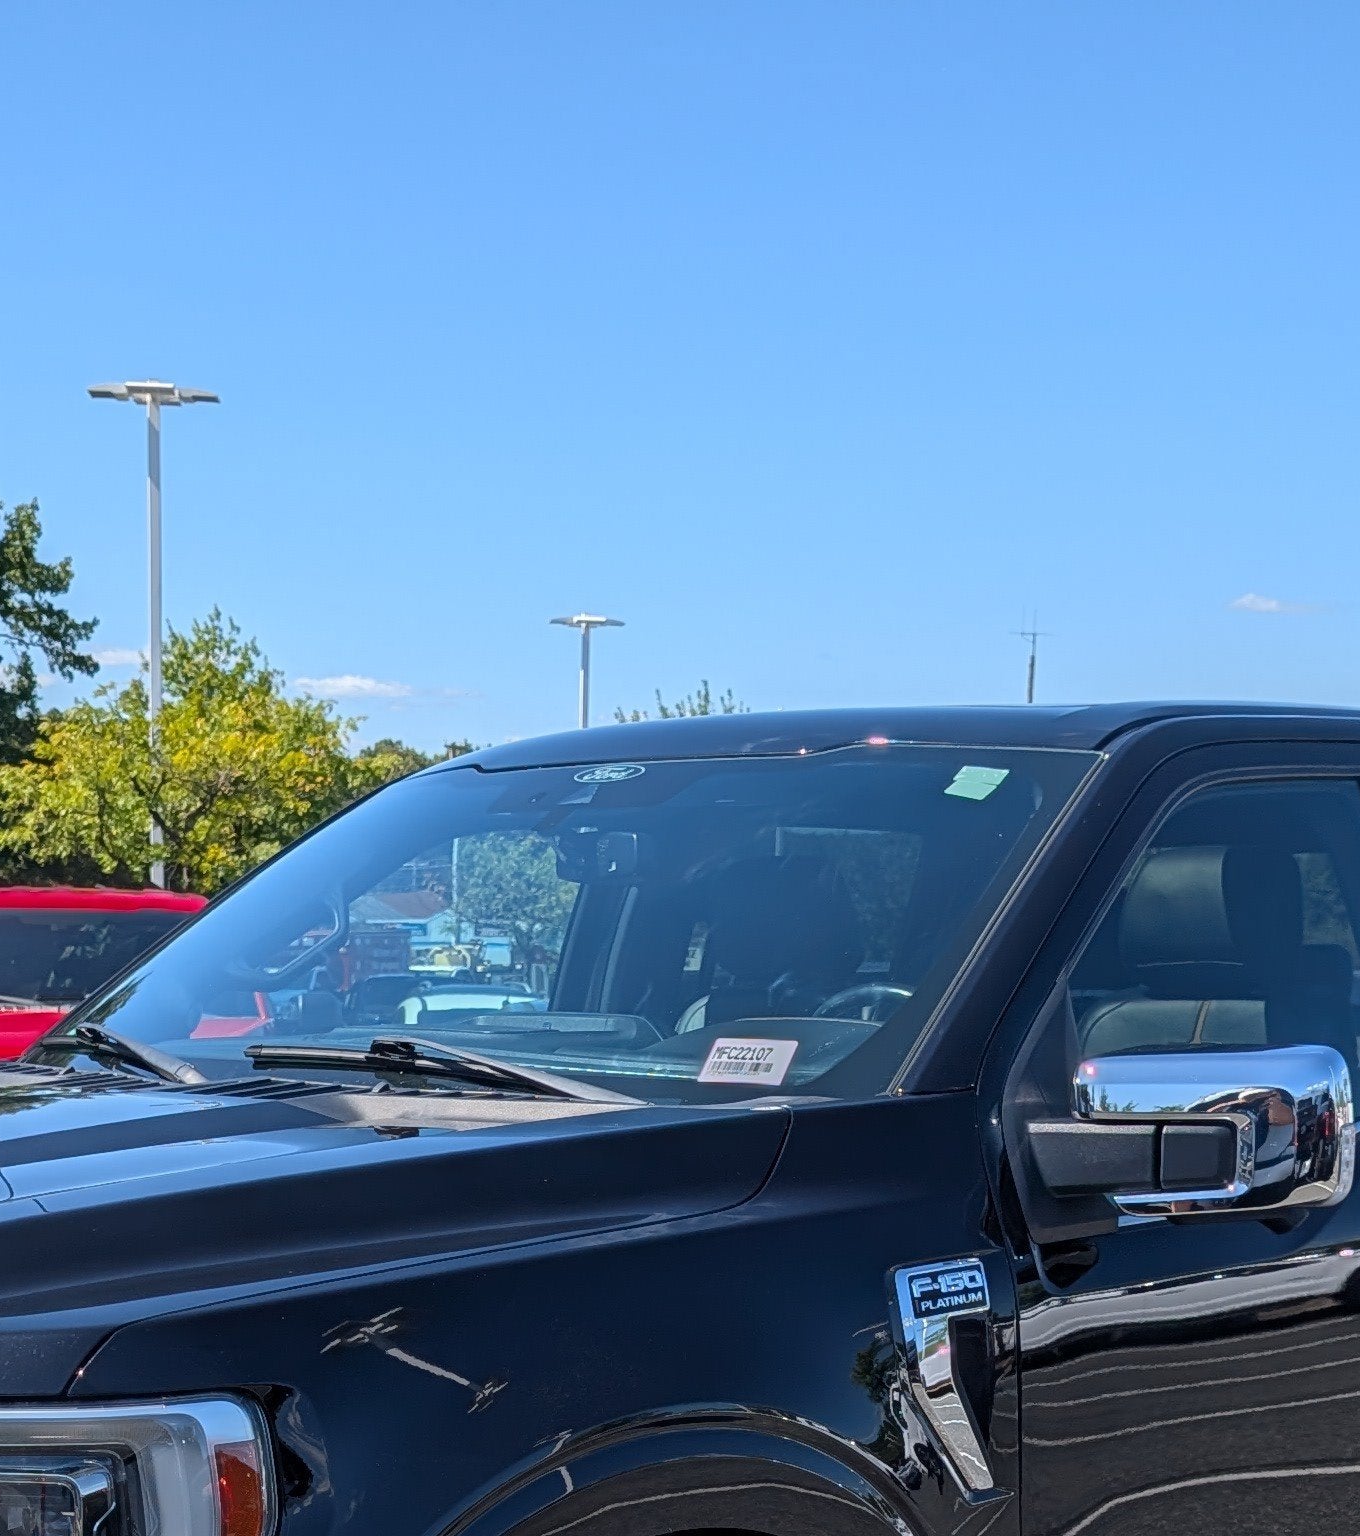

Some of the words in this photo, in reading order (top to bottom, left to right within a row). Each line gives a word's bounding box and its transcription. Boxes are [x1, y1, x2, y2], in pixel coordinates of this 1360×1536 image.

[582, 766, 634, 780] Ford
[711, 1046, 774, 1061] MFC22107
[911, 1269, 983, 1297] F-150
[921, 1291, 982, 1312] PLATINUM
